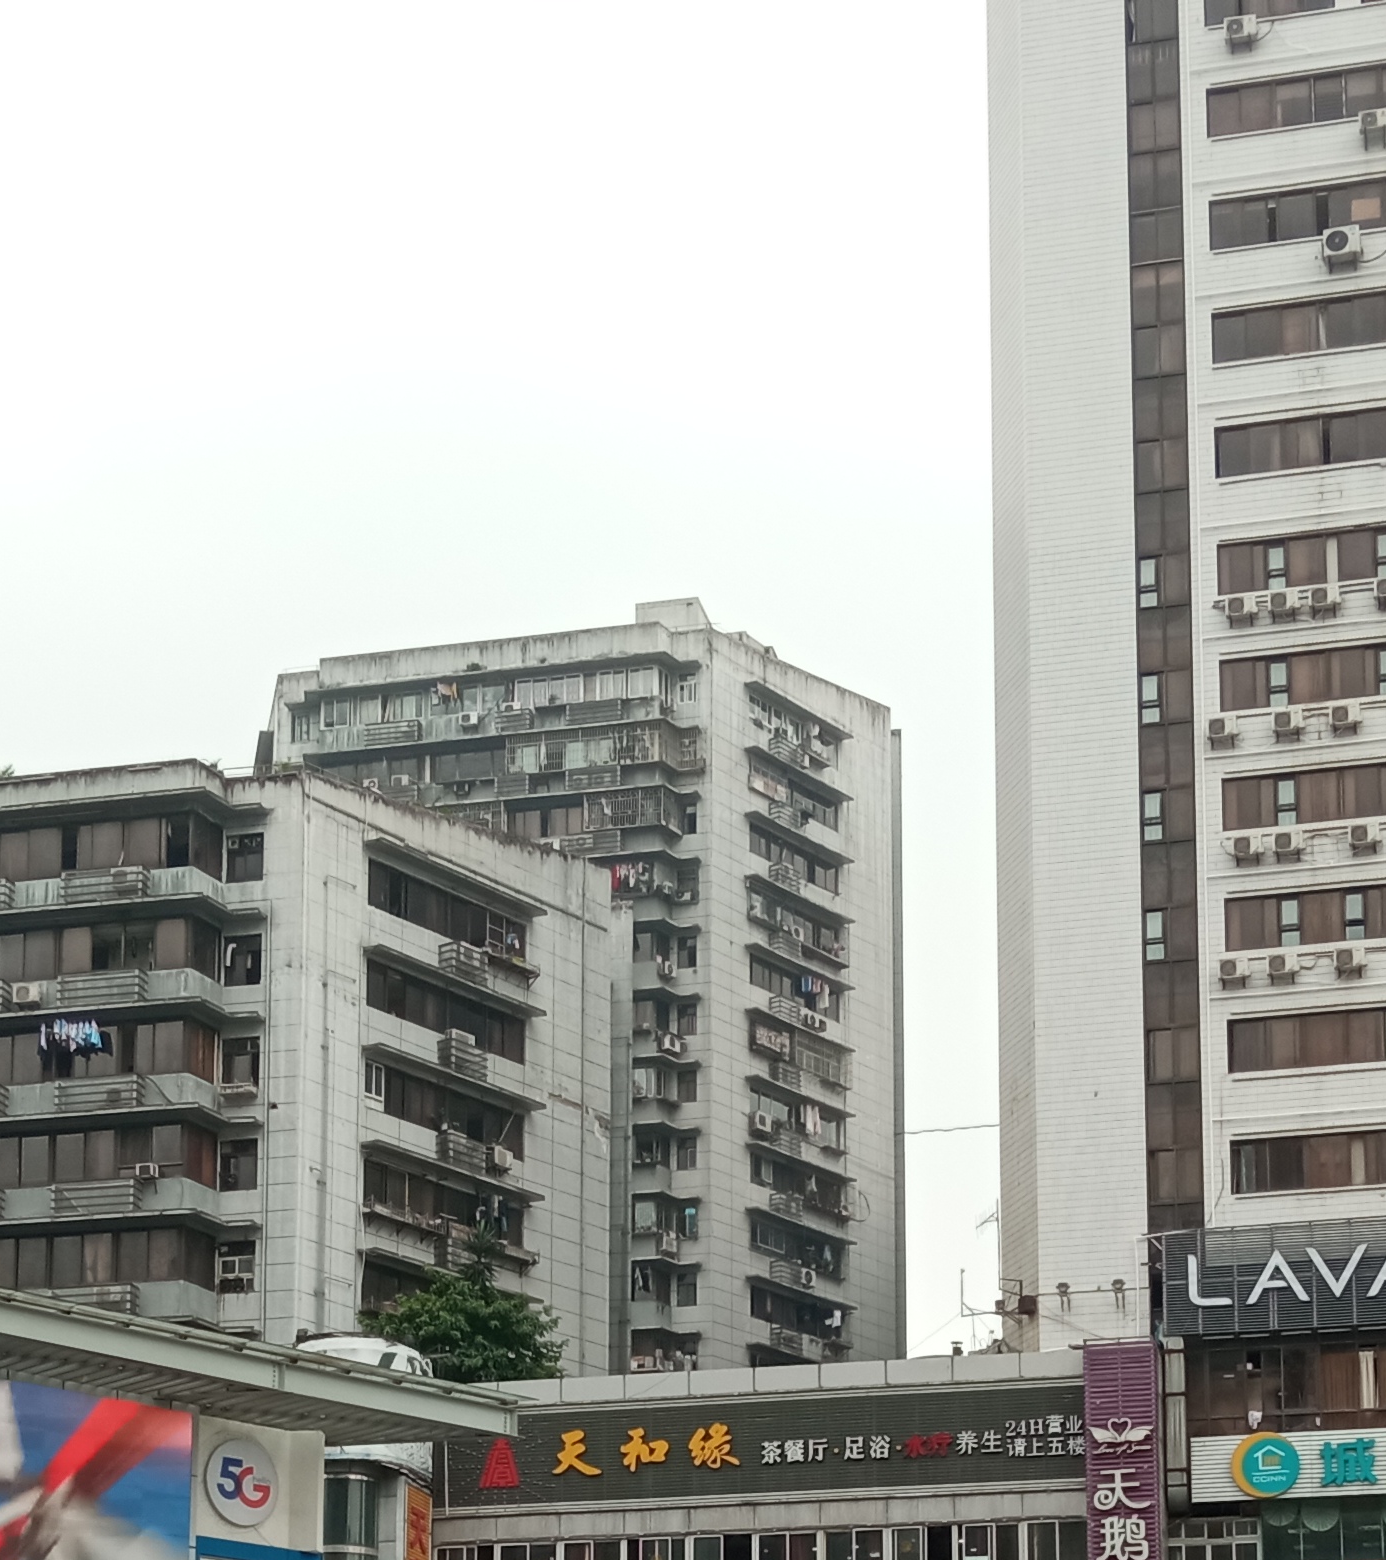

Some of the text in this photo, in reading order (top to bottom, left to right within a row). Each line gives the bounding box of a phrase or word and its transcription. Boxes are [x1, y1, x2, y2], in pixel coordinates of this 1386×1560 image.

[1006, 1415, 1084, 1436] 24H营业
[1006, 1436, 1086, 1458] 请上五楼
[216, 1456, 271, 1509] 5G
